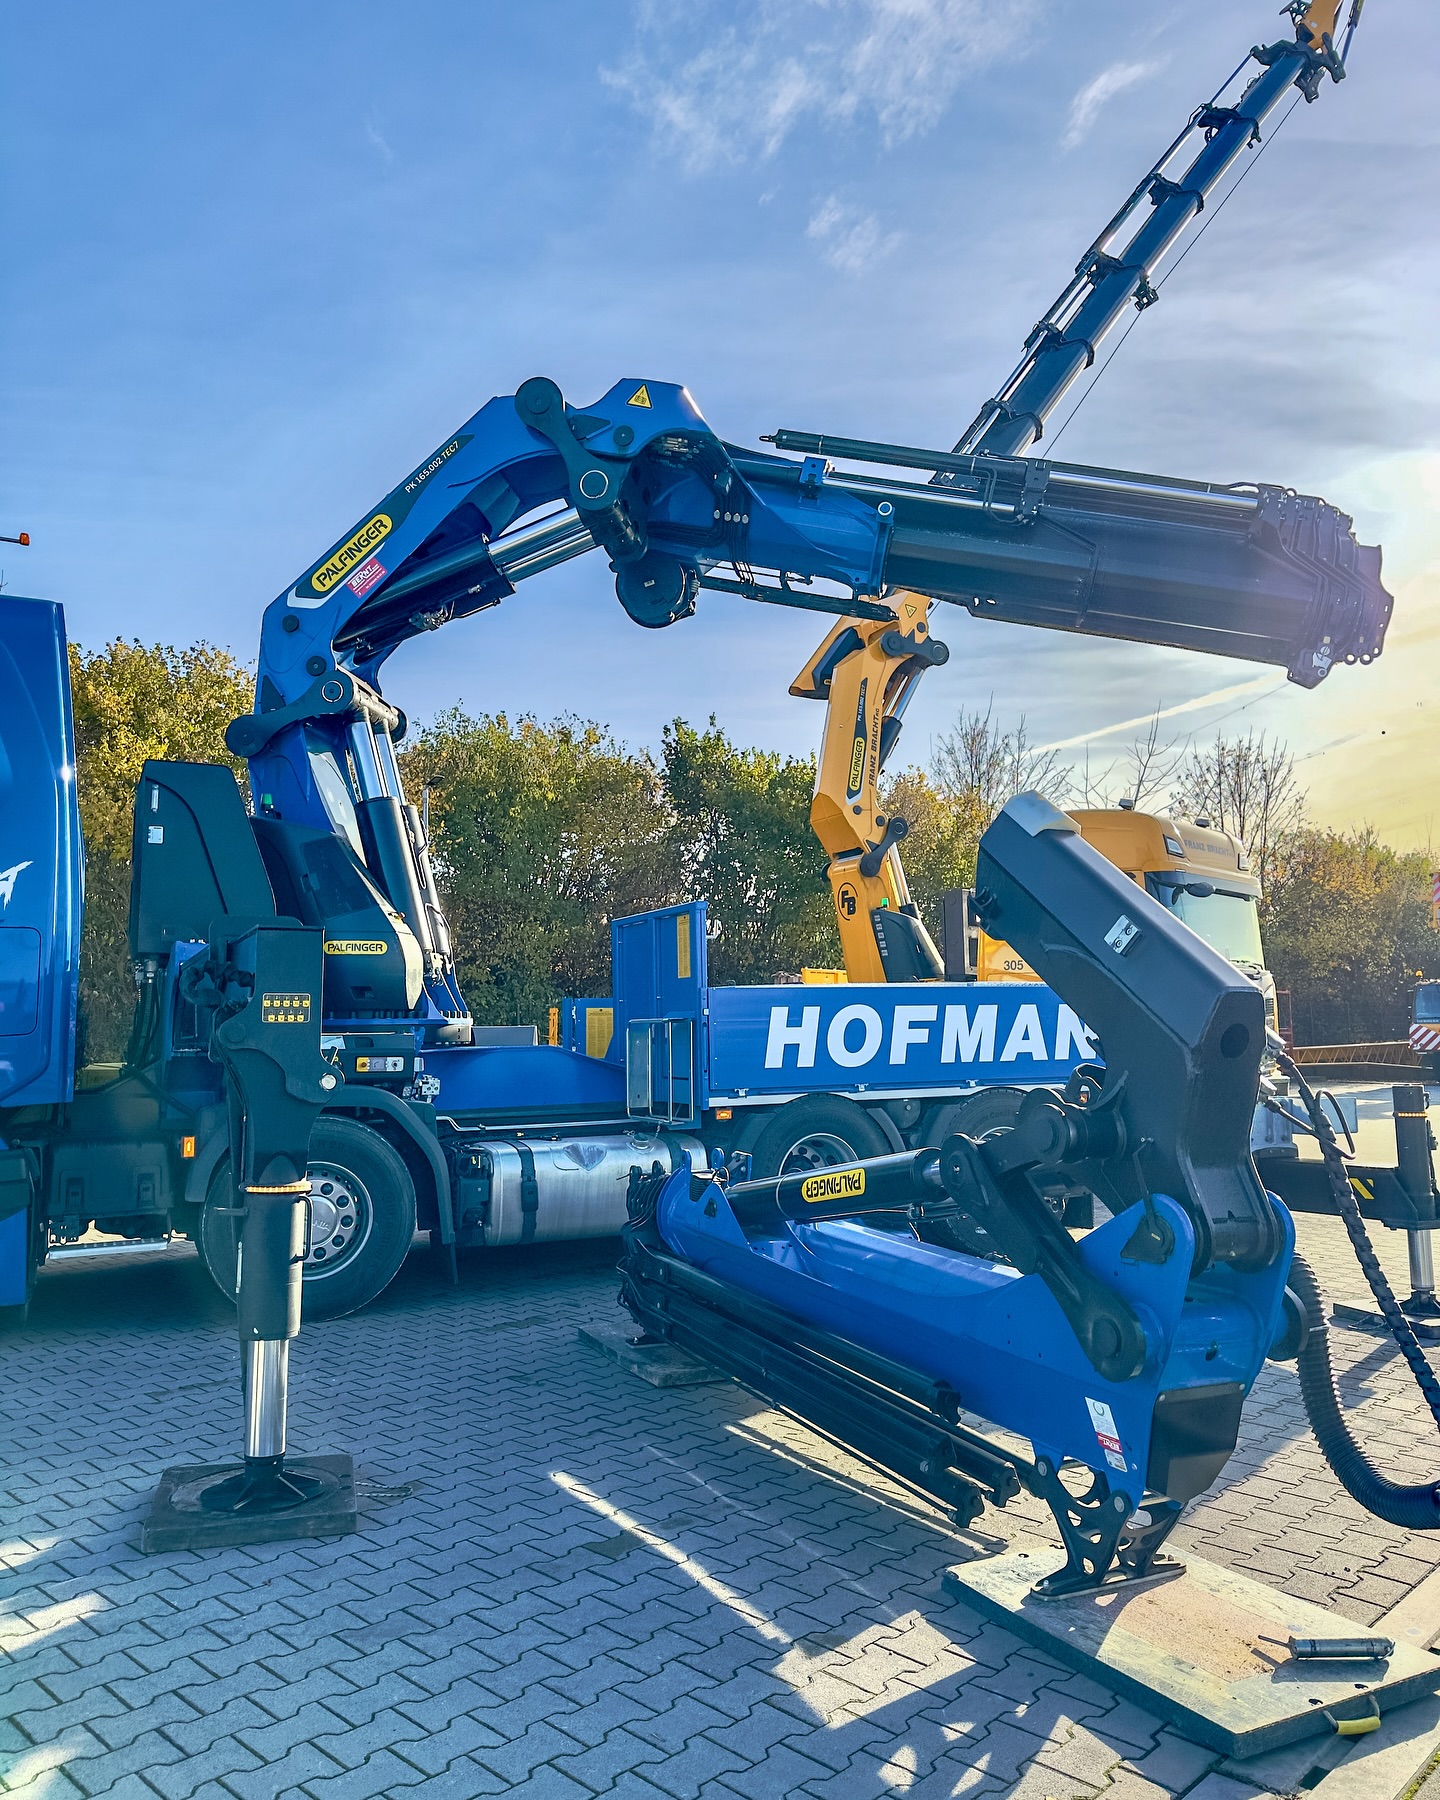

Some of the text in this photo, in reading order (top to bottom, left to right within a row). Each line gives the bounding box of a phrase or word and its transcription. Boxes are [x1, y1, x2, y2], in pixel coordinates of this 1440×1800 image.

[404, 440, 459, 493] PK 165.002 TEC7
[315, 518, 388, 588] PALFINGER
[350, 565, 374, 587] BERNT
[871, 714, 880, 752] BRACHT
[851, 740, 864, 788] PALFINGER
[868, 755, 877, 787] FRANZ
[327, 943, 383, 952] PALFINGER
[1003, 960, 1024, 971] 305
[805, 1172, 862, 1199] PALFINGER
